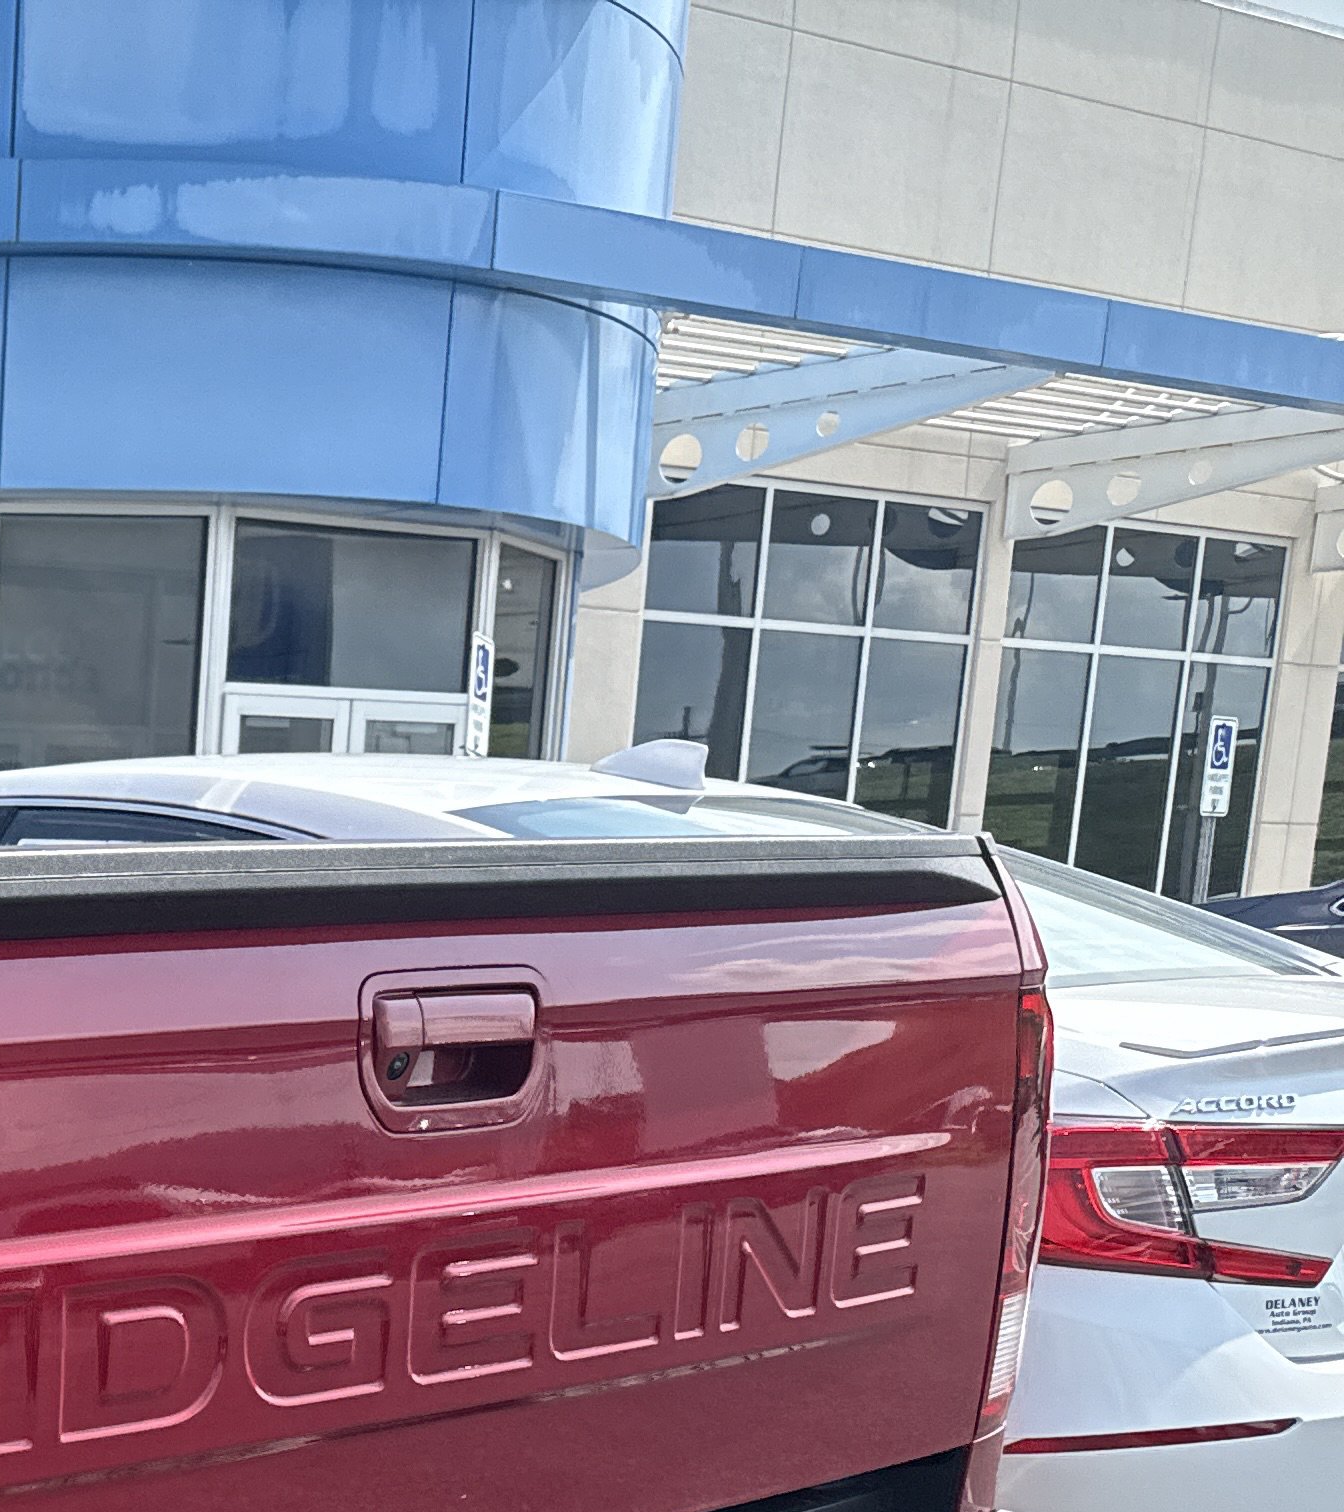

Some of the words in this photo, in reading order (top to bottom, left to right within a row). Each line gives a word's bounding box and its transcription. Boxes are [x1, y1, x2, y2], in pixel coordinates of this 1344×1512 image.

[1169, 1093, 1297, 1116] ACCORD
[1265, 1296, 1321, 1310] DELANEY
[1269, 1310, 1291, 1318] Auto
